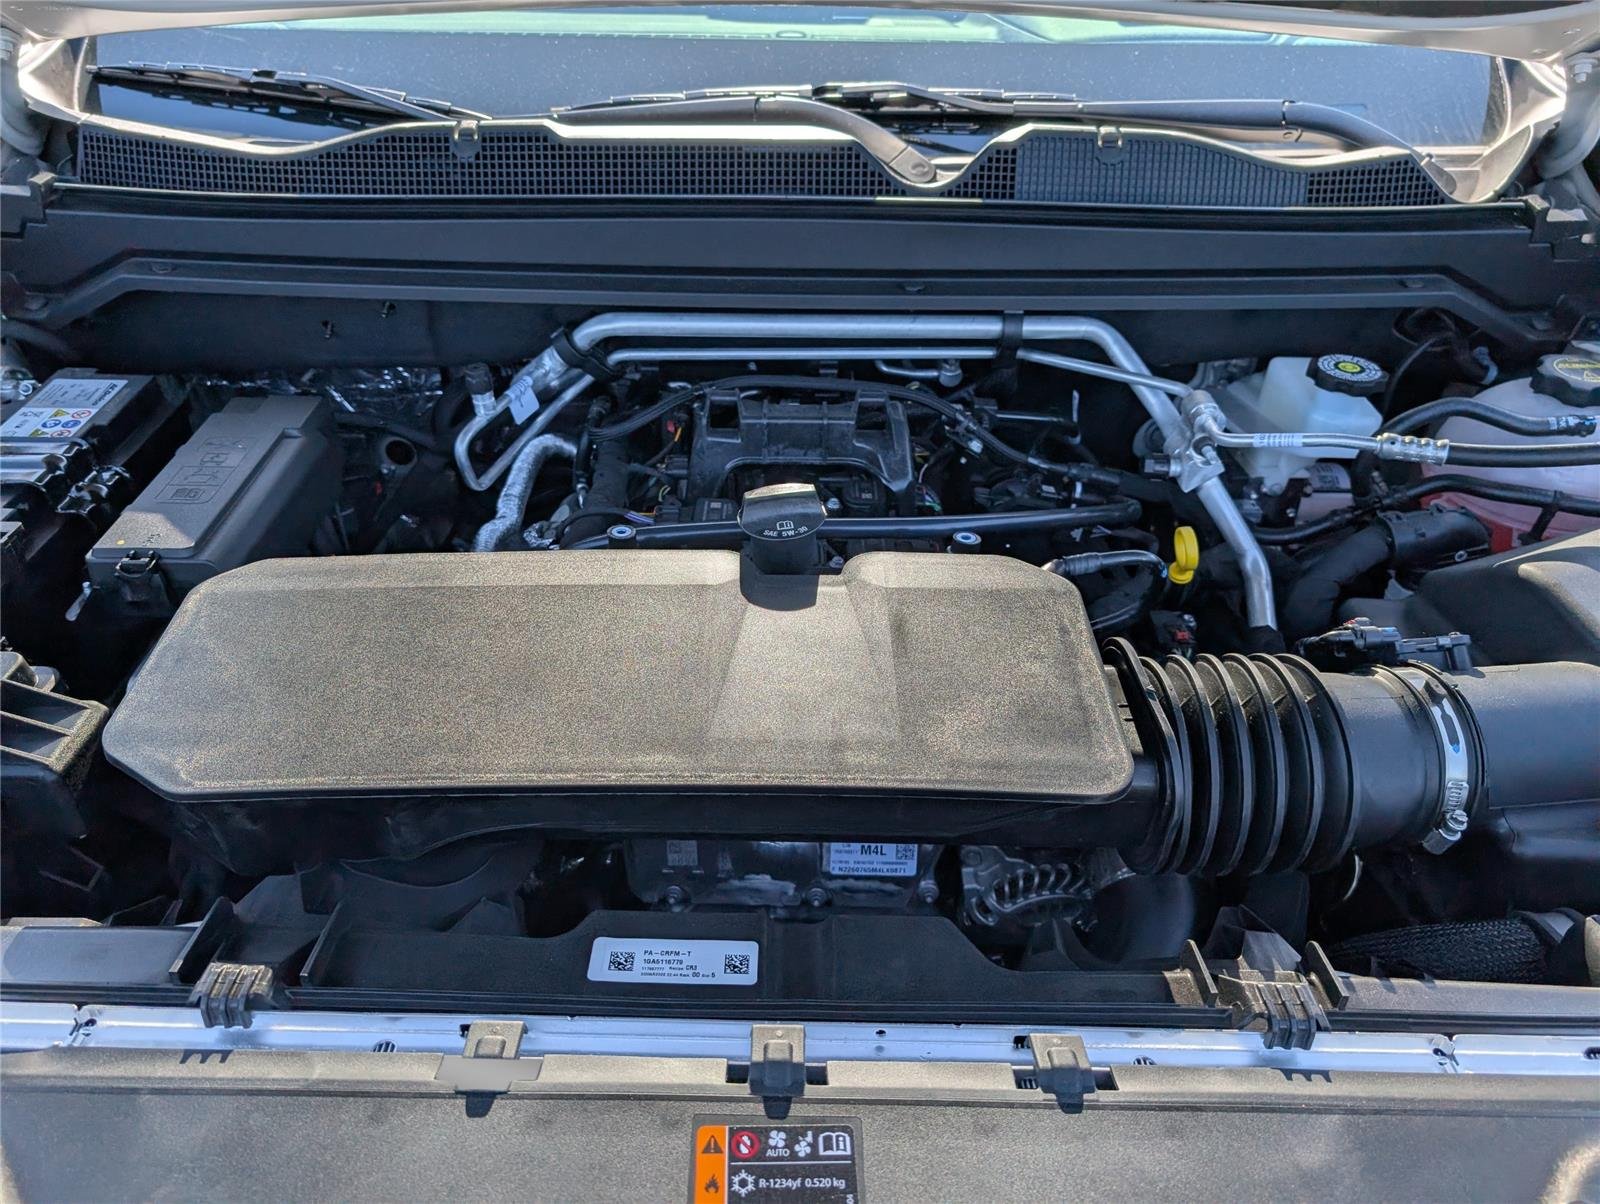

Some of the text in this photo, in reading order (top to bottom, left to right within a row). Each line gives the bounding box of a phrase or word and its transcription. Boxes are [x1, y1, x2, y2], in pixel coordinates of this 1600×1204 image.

[763, 526, 808, 537] SAE 5W-30
[860, 845, 887, 856] M4L
[766, 1148, 790, 1157] AUTO
[758, 1177, 846, 1190] R-1234yf 0.520 kg
